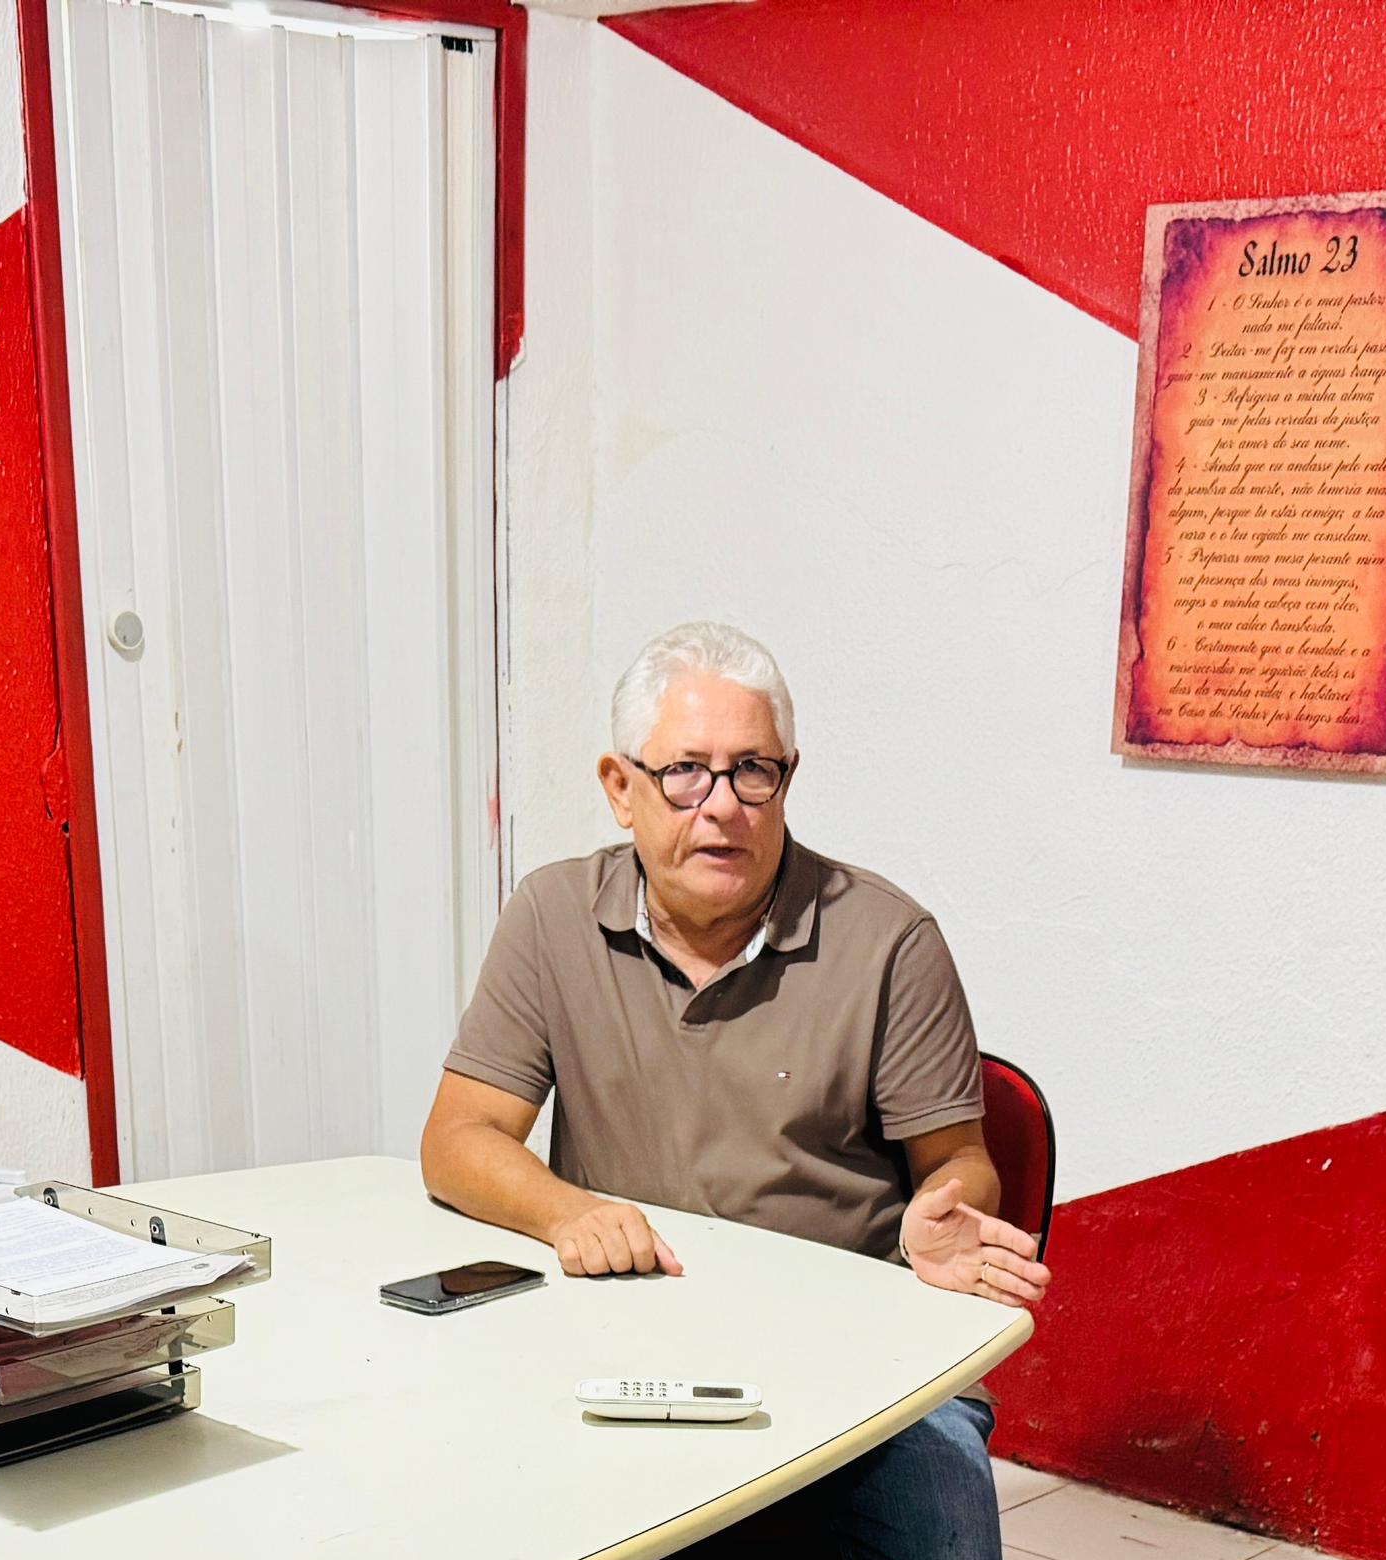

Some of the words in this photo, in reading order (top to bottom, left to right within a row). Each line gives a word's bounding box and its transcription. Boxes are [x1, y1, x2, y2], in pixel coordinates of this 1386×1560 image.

[1238, 240, 1311, 277] Salmo
[1320, 235, 1358, 274] 23
[1207, 296, 1216, 311] 1
[1233, 295, 1245, 310] O
[1249, 290, 1288, 309] Senhor
[1317, 297, 1342, 307] meu
[1243, 314, 1272, 333] nada
[1277, 322, 1293, 332] me
[1293, 312, 1342, 340] faltará.
[1182, 343, 1192, 358] 2
[1272, 339, 1294, 363] faz
[1299, 345, 1315, 354] em
[1322, 336, 1357, 354] verdes
[1222, 365, 1293, 380] mansamente
[1312, 363, 1345, 385] águas
[1194, 389, 1207, 405] 3
[1223, 386, 1280, 411] Refrigera
[1284, 392, 1292, 401] a
[1297, 383, 1336, 401] minha
[1238, 407, 1271, 433] pelas
[1275, 407, 1317, 425] veredas
[1322, 406, 1337, 425] da
[1333, 411, 1380, 433] justiça
[1210, 439, 1234, 457] por
[1238, 440, 1268, 449] amor
[1273, 430, 1287, 449] do
[1290, 439, 1311, 449] seu
[1315, 440, 1350, 449] nome.
[1238, 462, 1265, 487] que
[1269, 463, 1283, 471] eu
[1287, 454, 1333, 472] andasse
[1331, 454, 1361, 479] pelo
[1167, 477, 1182, 496] da
[1185, 478, 1226, 496] sombra
[1230, 481, 1244, 495] da
[1292, 482, 1314, 495] não
[1317, 482, 1363, 495] temeria
[1169, 501, 1207, 526] algum,
[1208, 507, 1252, 526] porque
[1255, 504, 1267, 518] tu
[1271, 504, 1297, 518] estás
[1352, 510, 1361, 518] a
[1365, 506, 1385, 519] tua
[1179, 531, 1205, 541] vara
[1231, 528, 1247, 541] teu
[1252, 523, 1288, 549] cajado
[1292, 532, 1310, 541] me
[1313, 523, 1371, 542] consolam.
[1161, 546, 1175, 565] 5
[1188, 547, 1240, 570] Preparas
[1244, 554, 1270, 564] uma
[1275, 554, 1304, 564] mesa
[1302, 552, 1352, 571] perante
[1356, 554, 1385, 565] mim
[1178, 576, 1194, 585] na
[1193, 574, 1245, 591] presença
[1250, 569, 1267, 586] dos
[1273, 577, 1301, 587] meus
[1174, 598, 1206, 614] unges
[1223, 591, 1260, 609] minha
[1264, 592, 1301, 612] cabeça
[1305, 600, 1329, 610] com
[1209, 621, 1233, 630] meu
[1236, 614, 1267, 630] cálice
[1271, 615, 1335, 633] transborda.
[1166, 636, 1176, 651] 6
[1194, 636, 1257, 654] Certamente
[1258, 644, 1281, 660] que
[1285, 646, 1294, 655] a
[1298, 639, 1347, 656] bondade
[1362, 648, 1371, 657] a
[1239, 665, 1255, 674] me
[1259, 665, 1306, 682] seguirão
[1311, 661, 1339, 678] todos
[1343, 668, 1355, 679] os
[1169, 678, 1192, 695] dias
[1195, 679, 1210, 696] da
[1214, 680, 1251, 697] minha
[1300, 683, 1352, 701] habitarei
[1178, 702, 1206, 717] Casa
[1209, 701, 1223, 718] do
[1228, 702, 1267, 721] Senhor
[1266, 709, 1290, 727] por
[1294, 705, 1332, 729] longos
